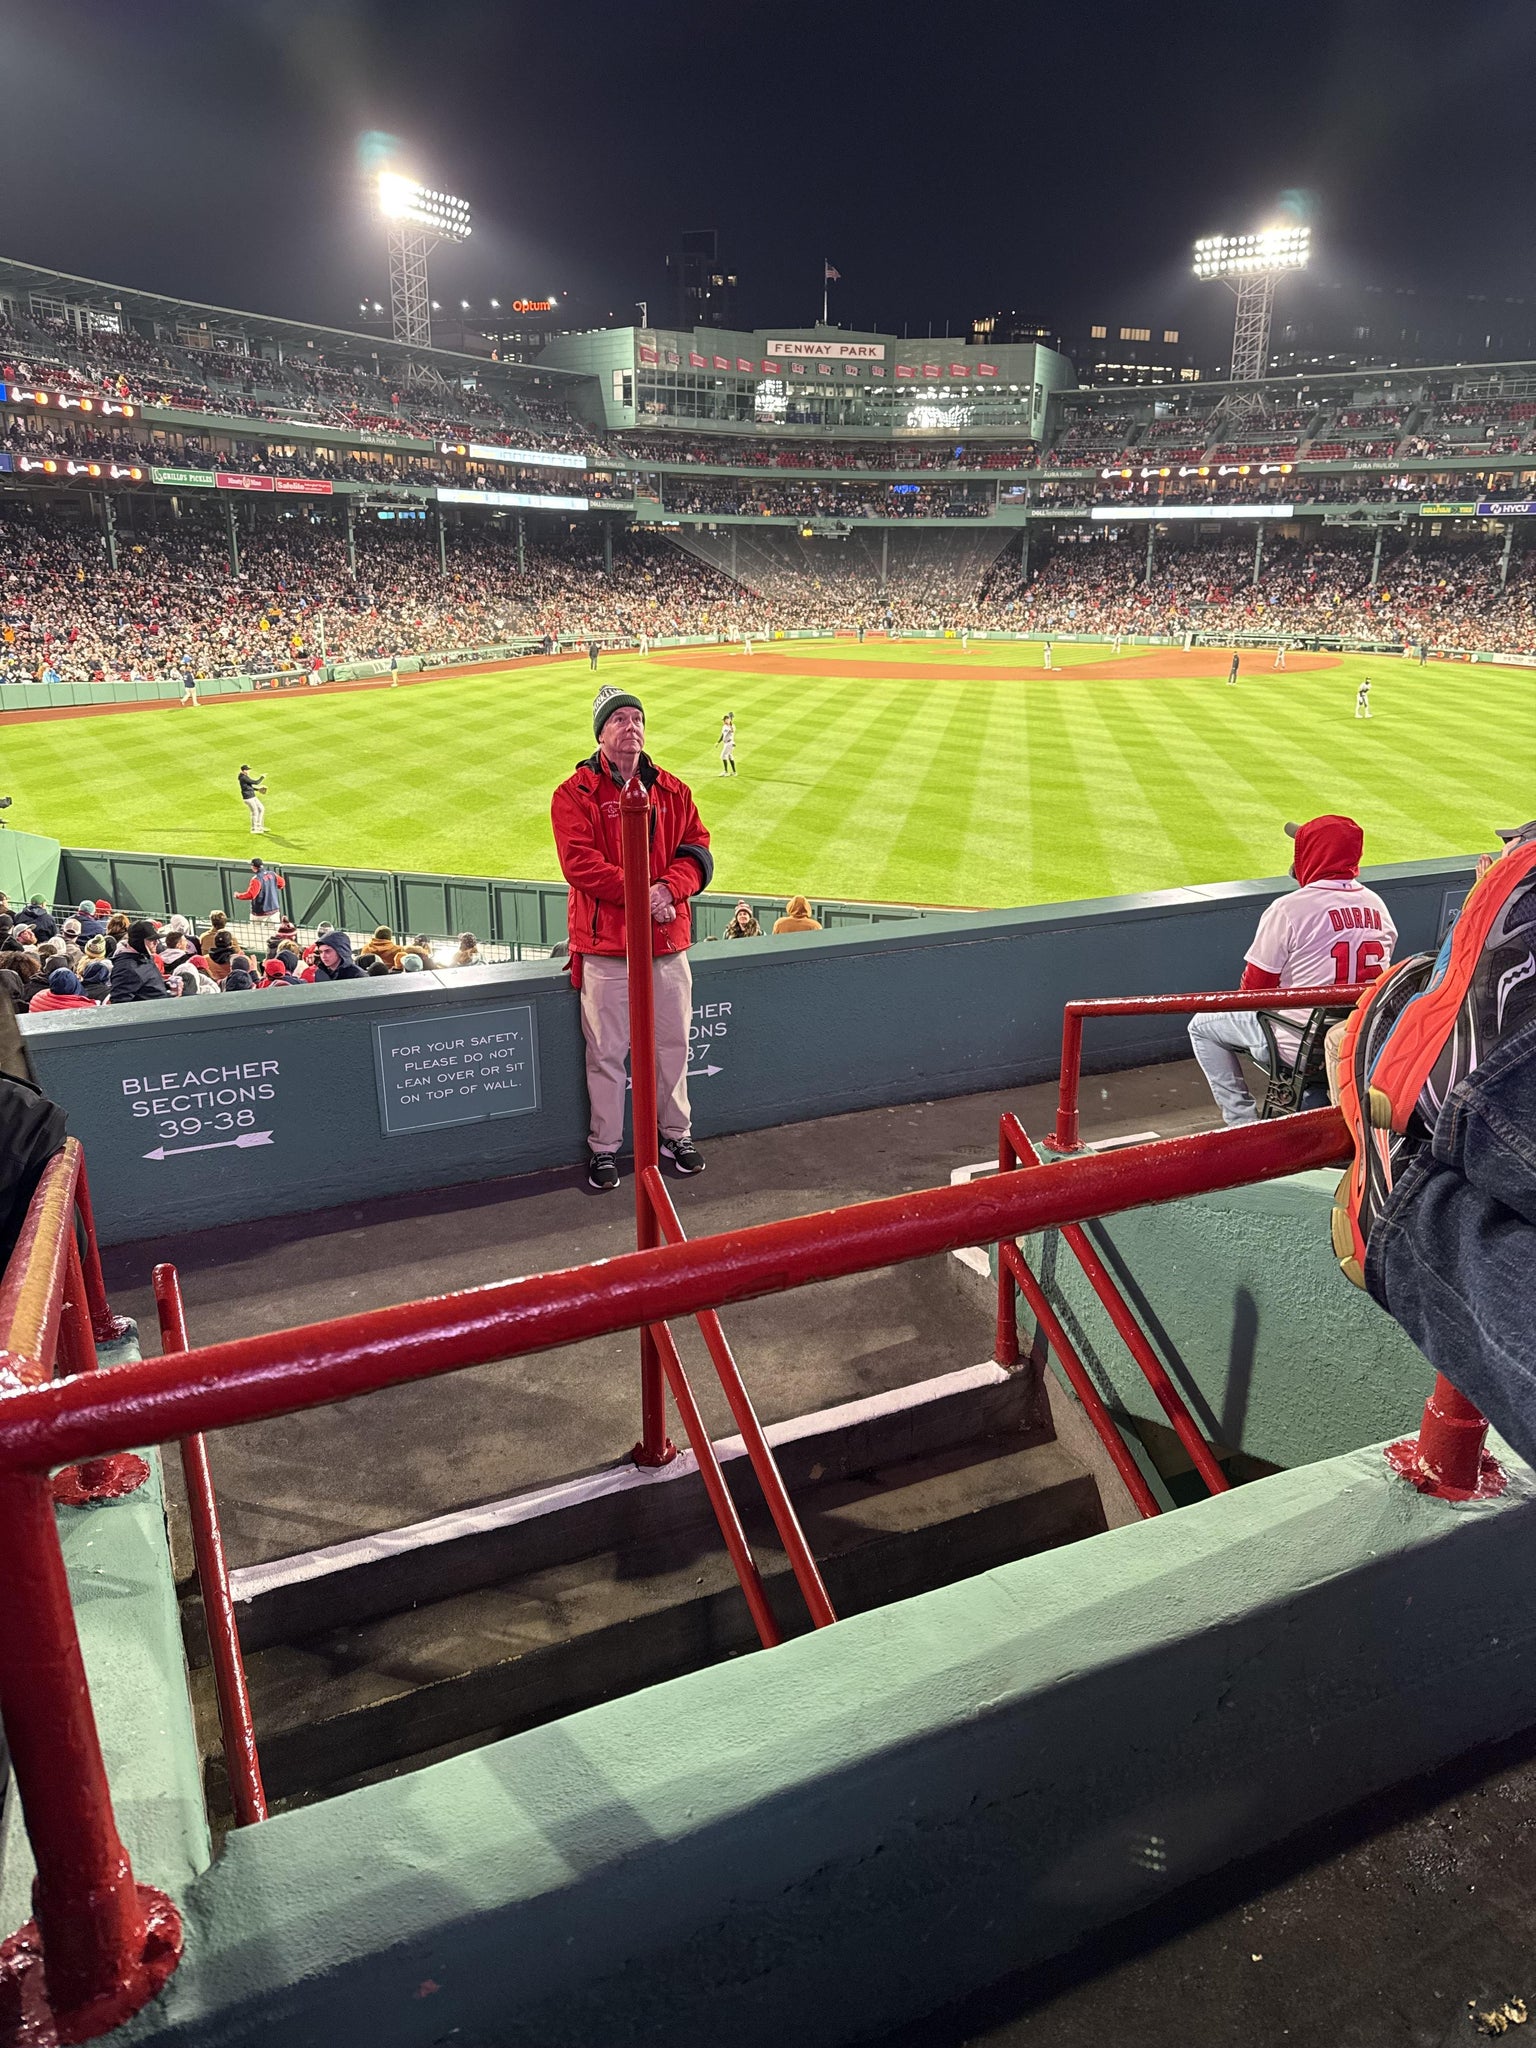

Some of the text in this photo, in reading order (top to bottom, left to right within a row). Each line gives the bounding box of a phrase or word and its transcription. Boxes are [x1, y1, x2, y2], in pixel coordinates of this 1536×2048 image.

[512, 300, 551, 314] Optum
[775, 343, 877, 356] FENWAY PARK
[189, 474, 213, 483] PICKLES
[277, 481, 305, 490] Safelite
[1502, 504, 1529, 513] HYCU
[1328, 907, 1383, 932] DURAN
[1330, 941, 1385, 984] 16
[391, 1045, 421, 1058] FOR
[427, 1039, 465, 1052] YOUR
[404, 1047, 516, 1072] PLEASE DO NOT
[122, 1060, 280, 1096] BLEACHER
[437, 1069, 475, 1083] OVER
[480, 1065, 500, 1077] OR
[505, 1061, 525, 1073] SIT
[132, 1083, 276, 1118] SECTIONS
[400, 1079, 522, 1105] ON TOP OF WALL.
[158, 1109, 256, 1139] 39-38
